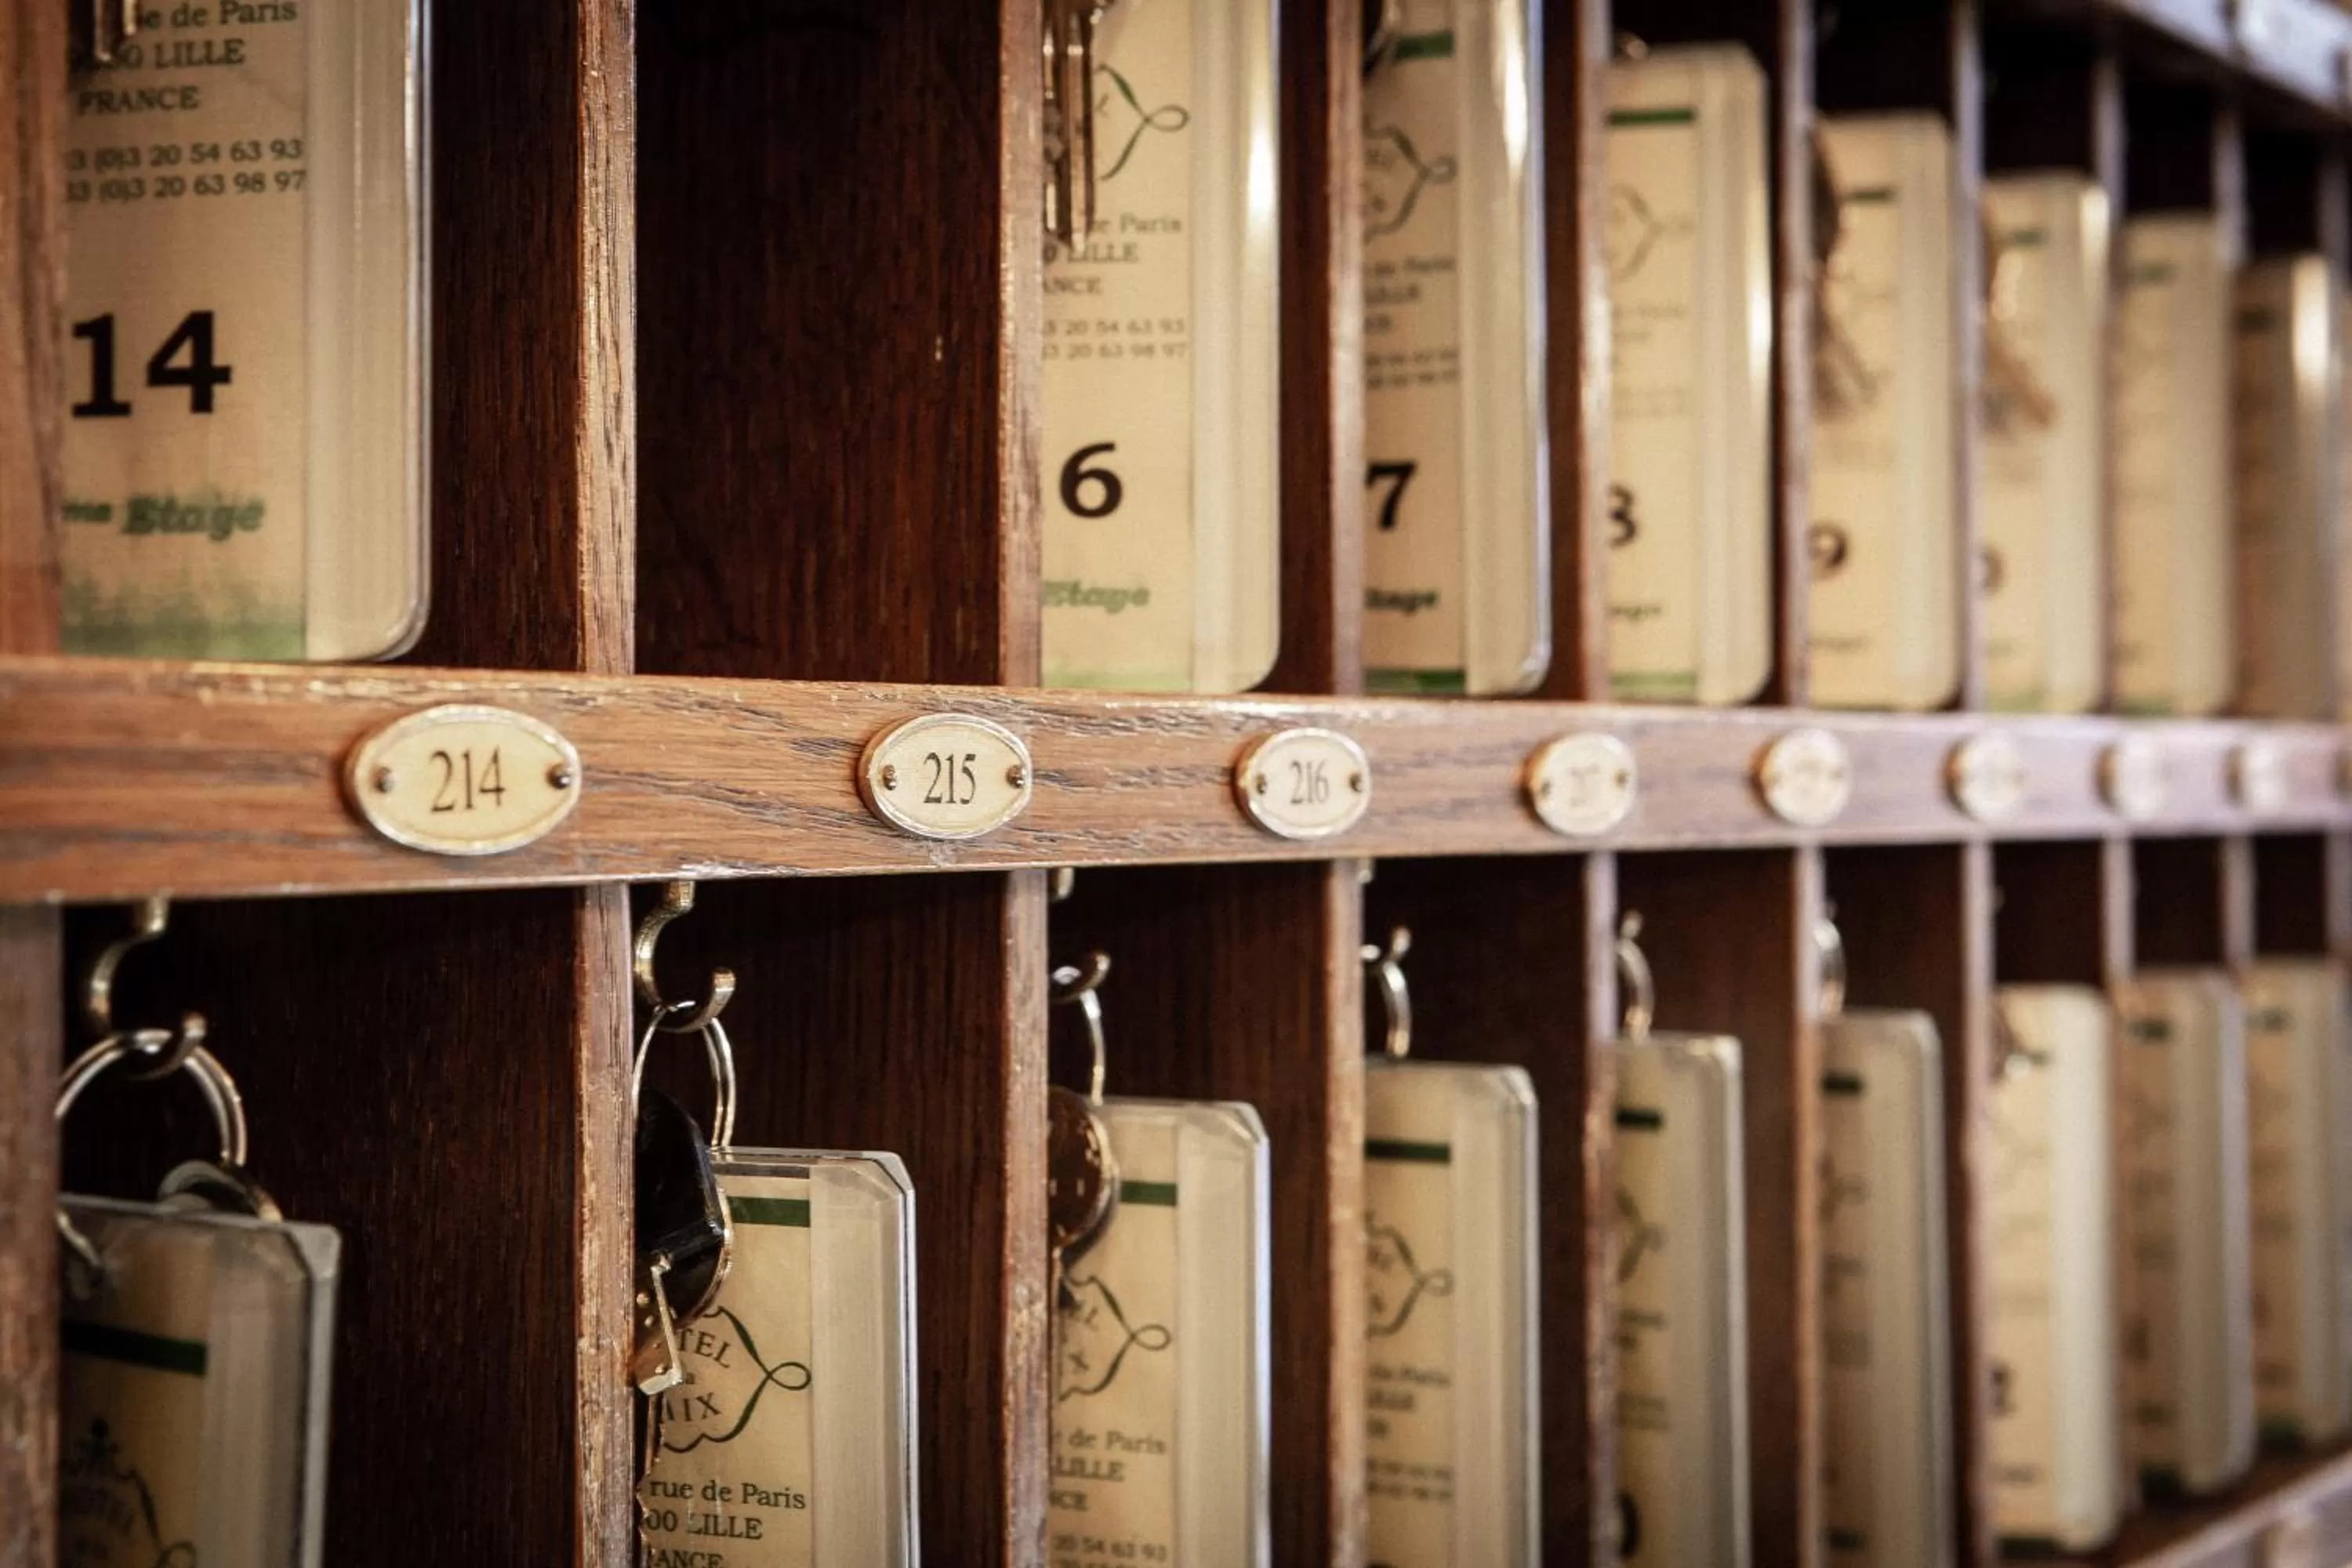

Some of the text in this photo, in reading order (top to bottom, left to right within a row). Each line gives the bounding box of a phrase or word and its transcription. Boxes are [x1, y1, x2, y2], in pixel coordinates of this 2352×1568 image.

[171, 2, 208, 28] de
[220, 0, 298, 25] Paris
[154, 38, 246, 69] LILLE
[190, 142, 222, 165] 54
[230, 139, 263, 163] 63
[270, 137, 304, 160] 93
[153, 174, 187, 198] 20
[193, 172, 227, 196] 63
[234, 170, 267, 194] 98
[274, 169, 307, 193] 97
[429, 746, 506, 812] 214
[924, 752, 977, 804] 215
[1288, 758, 1330, 805] 216
[649, 1479, 807, 1510] rue de Paris
